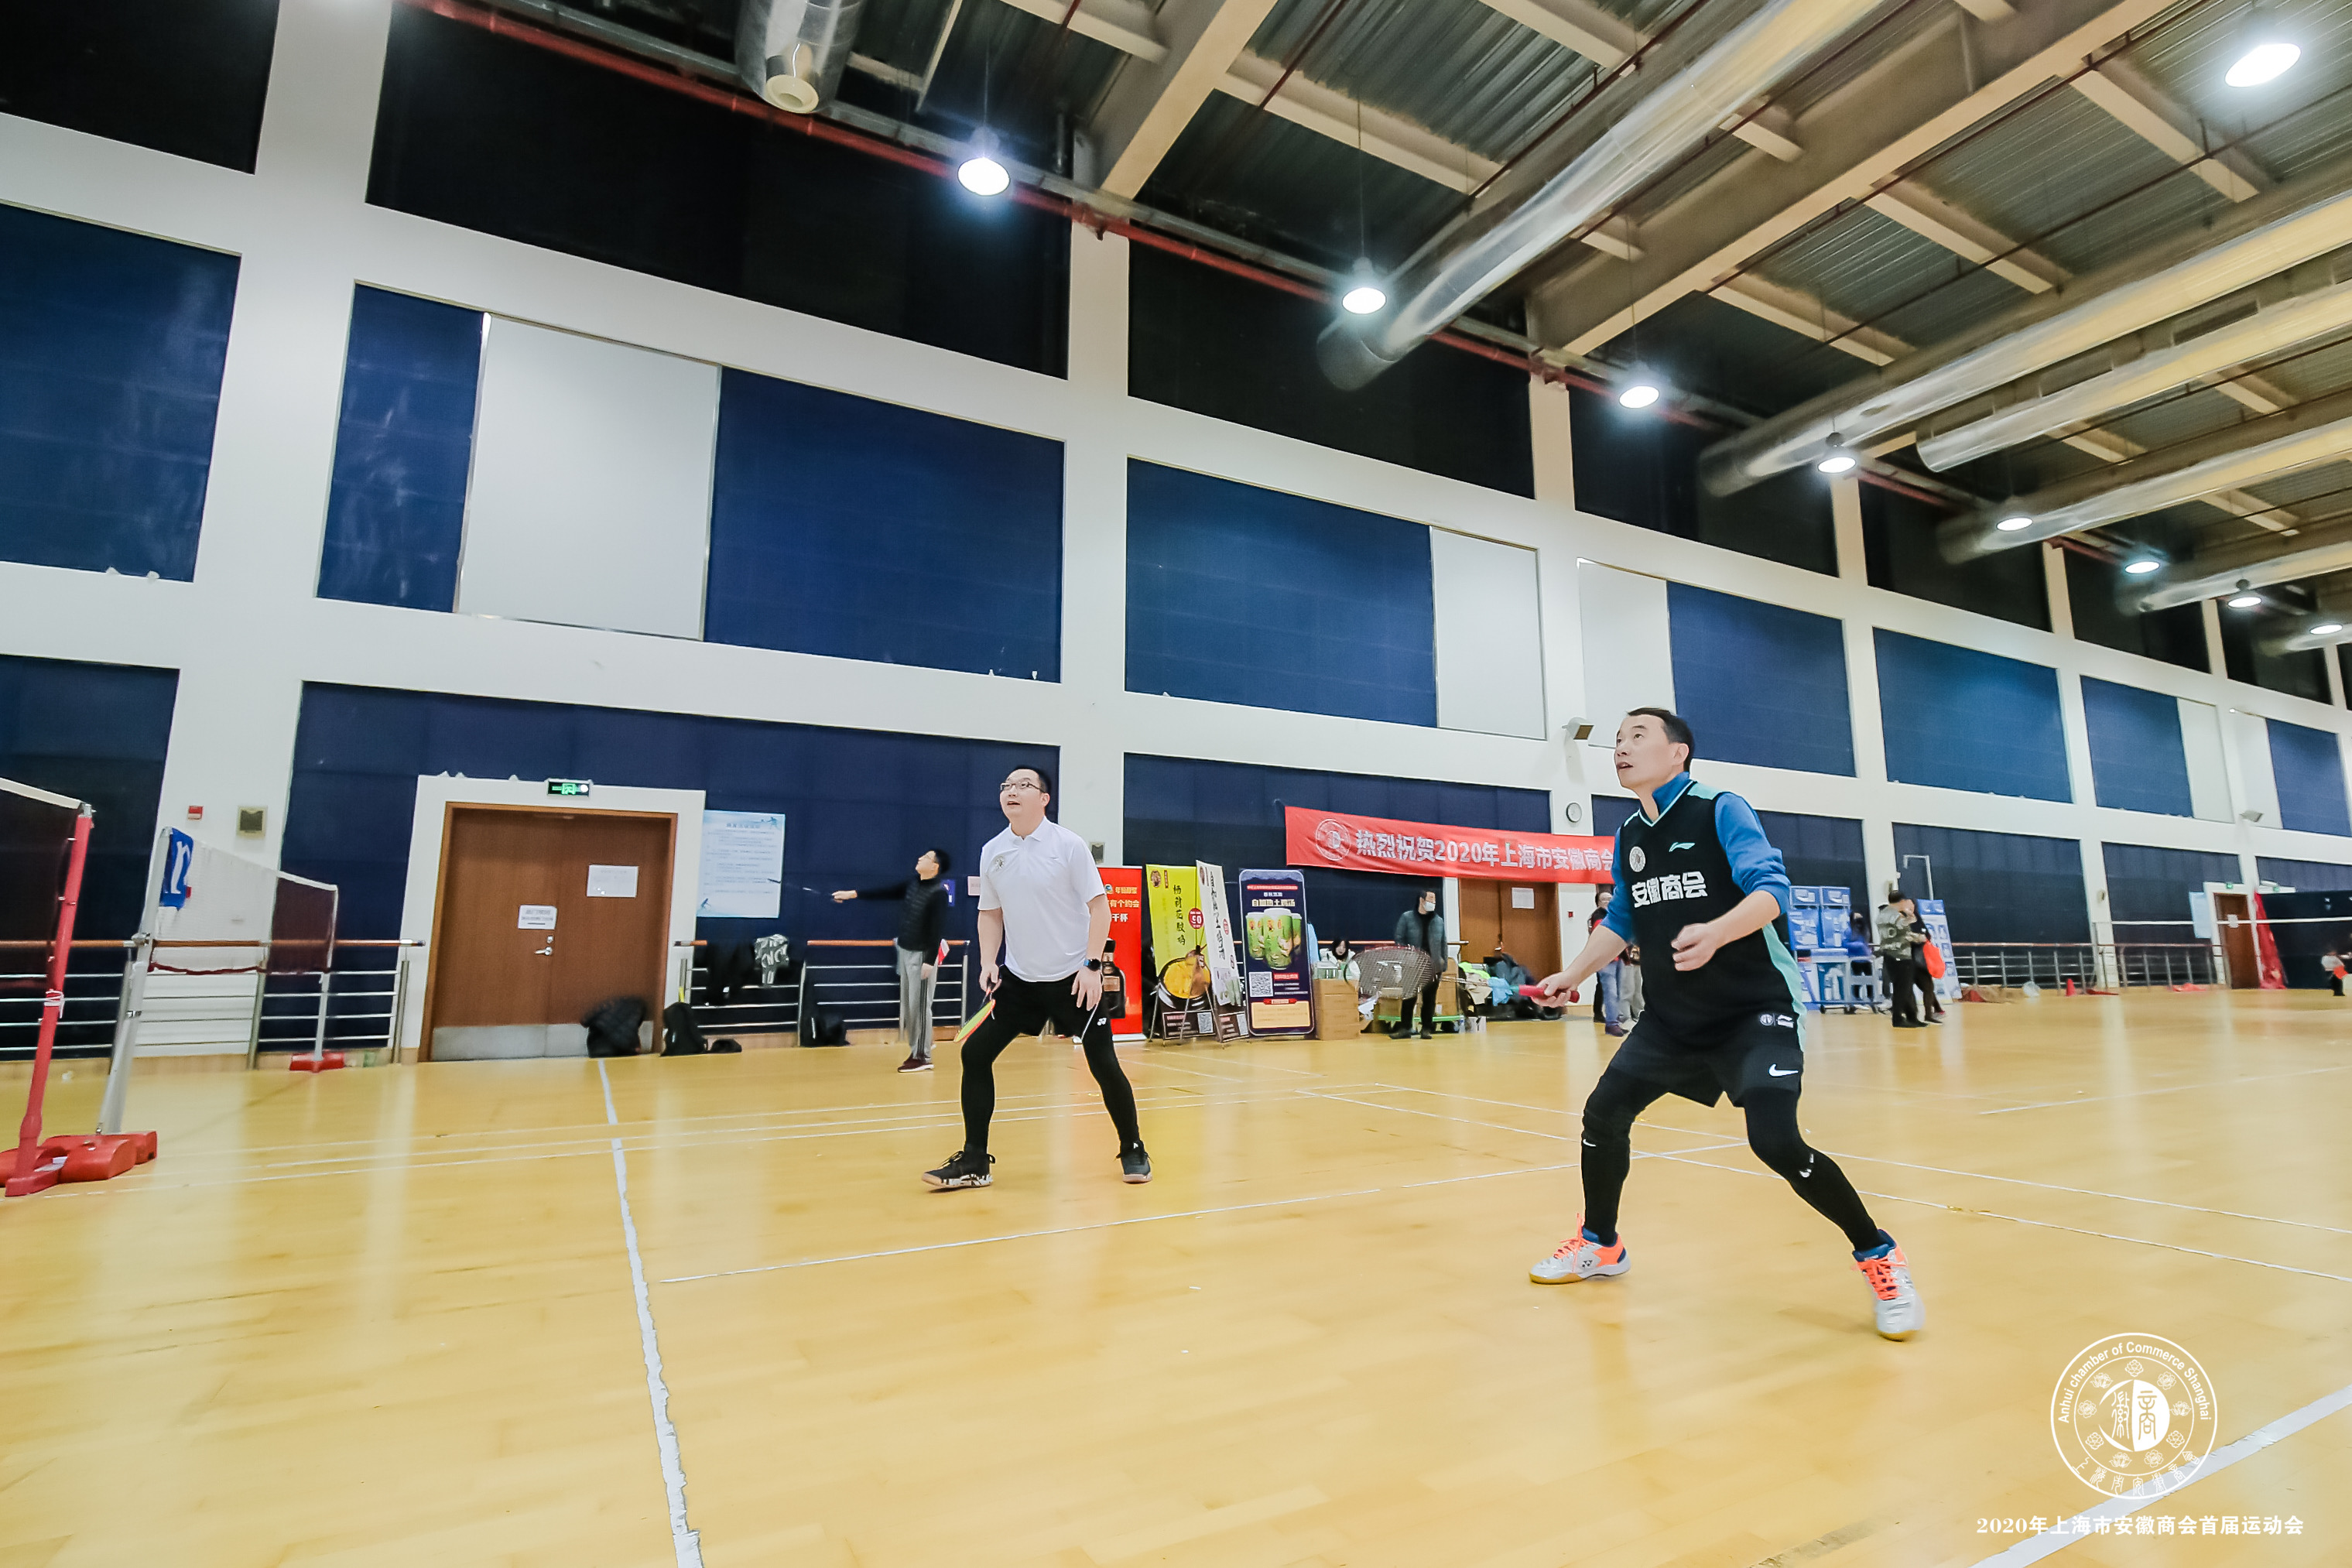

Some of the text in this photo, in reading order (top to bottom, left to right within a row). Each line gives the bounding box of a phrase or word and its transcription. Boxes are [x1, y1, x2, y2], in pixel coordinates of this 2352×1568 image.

[1356, 830, 1614, 871] 热烈祝贺2020年上海市安徽商会
[1631, 871, 1708, 908] 安徽商会
